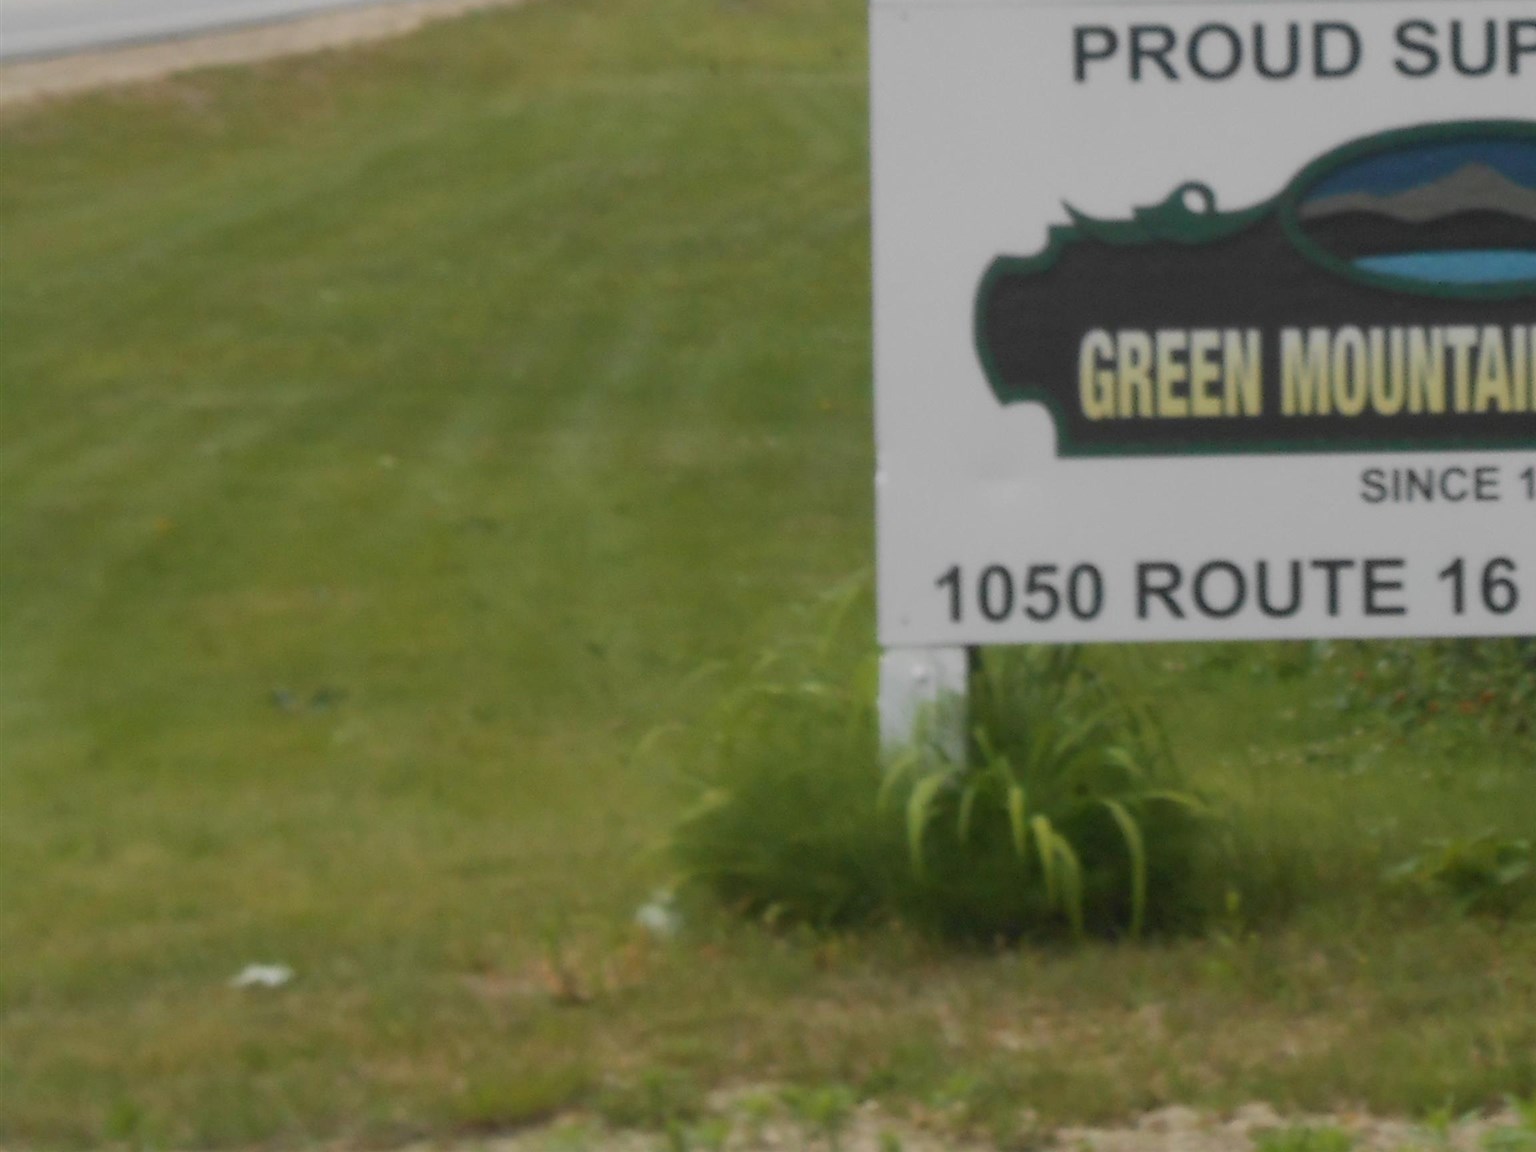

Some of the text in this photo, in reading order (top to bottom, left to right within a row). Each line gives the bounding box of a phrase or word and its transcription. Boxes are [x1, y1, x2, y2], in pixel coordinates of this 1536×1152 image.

[1072, 20, 1364, 84] PROUD
[1077, 328, 1263, 420] GREEN
[1359, 463, 1502, 505] SINCE
[936, 561, 1106, 624] 1050
[1134, 556, 1409, 621] ROUTE
[1437, 555, 1521, 617] 16
